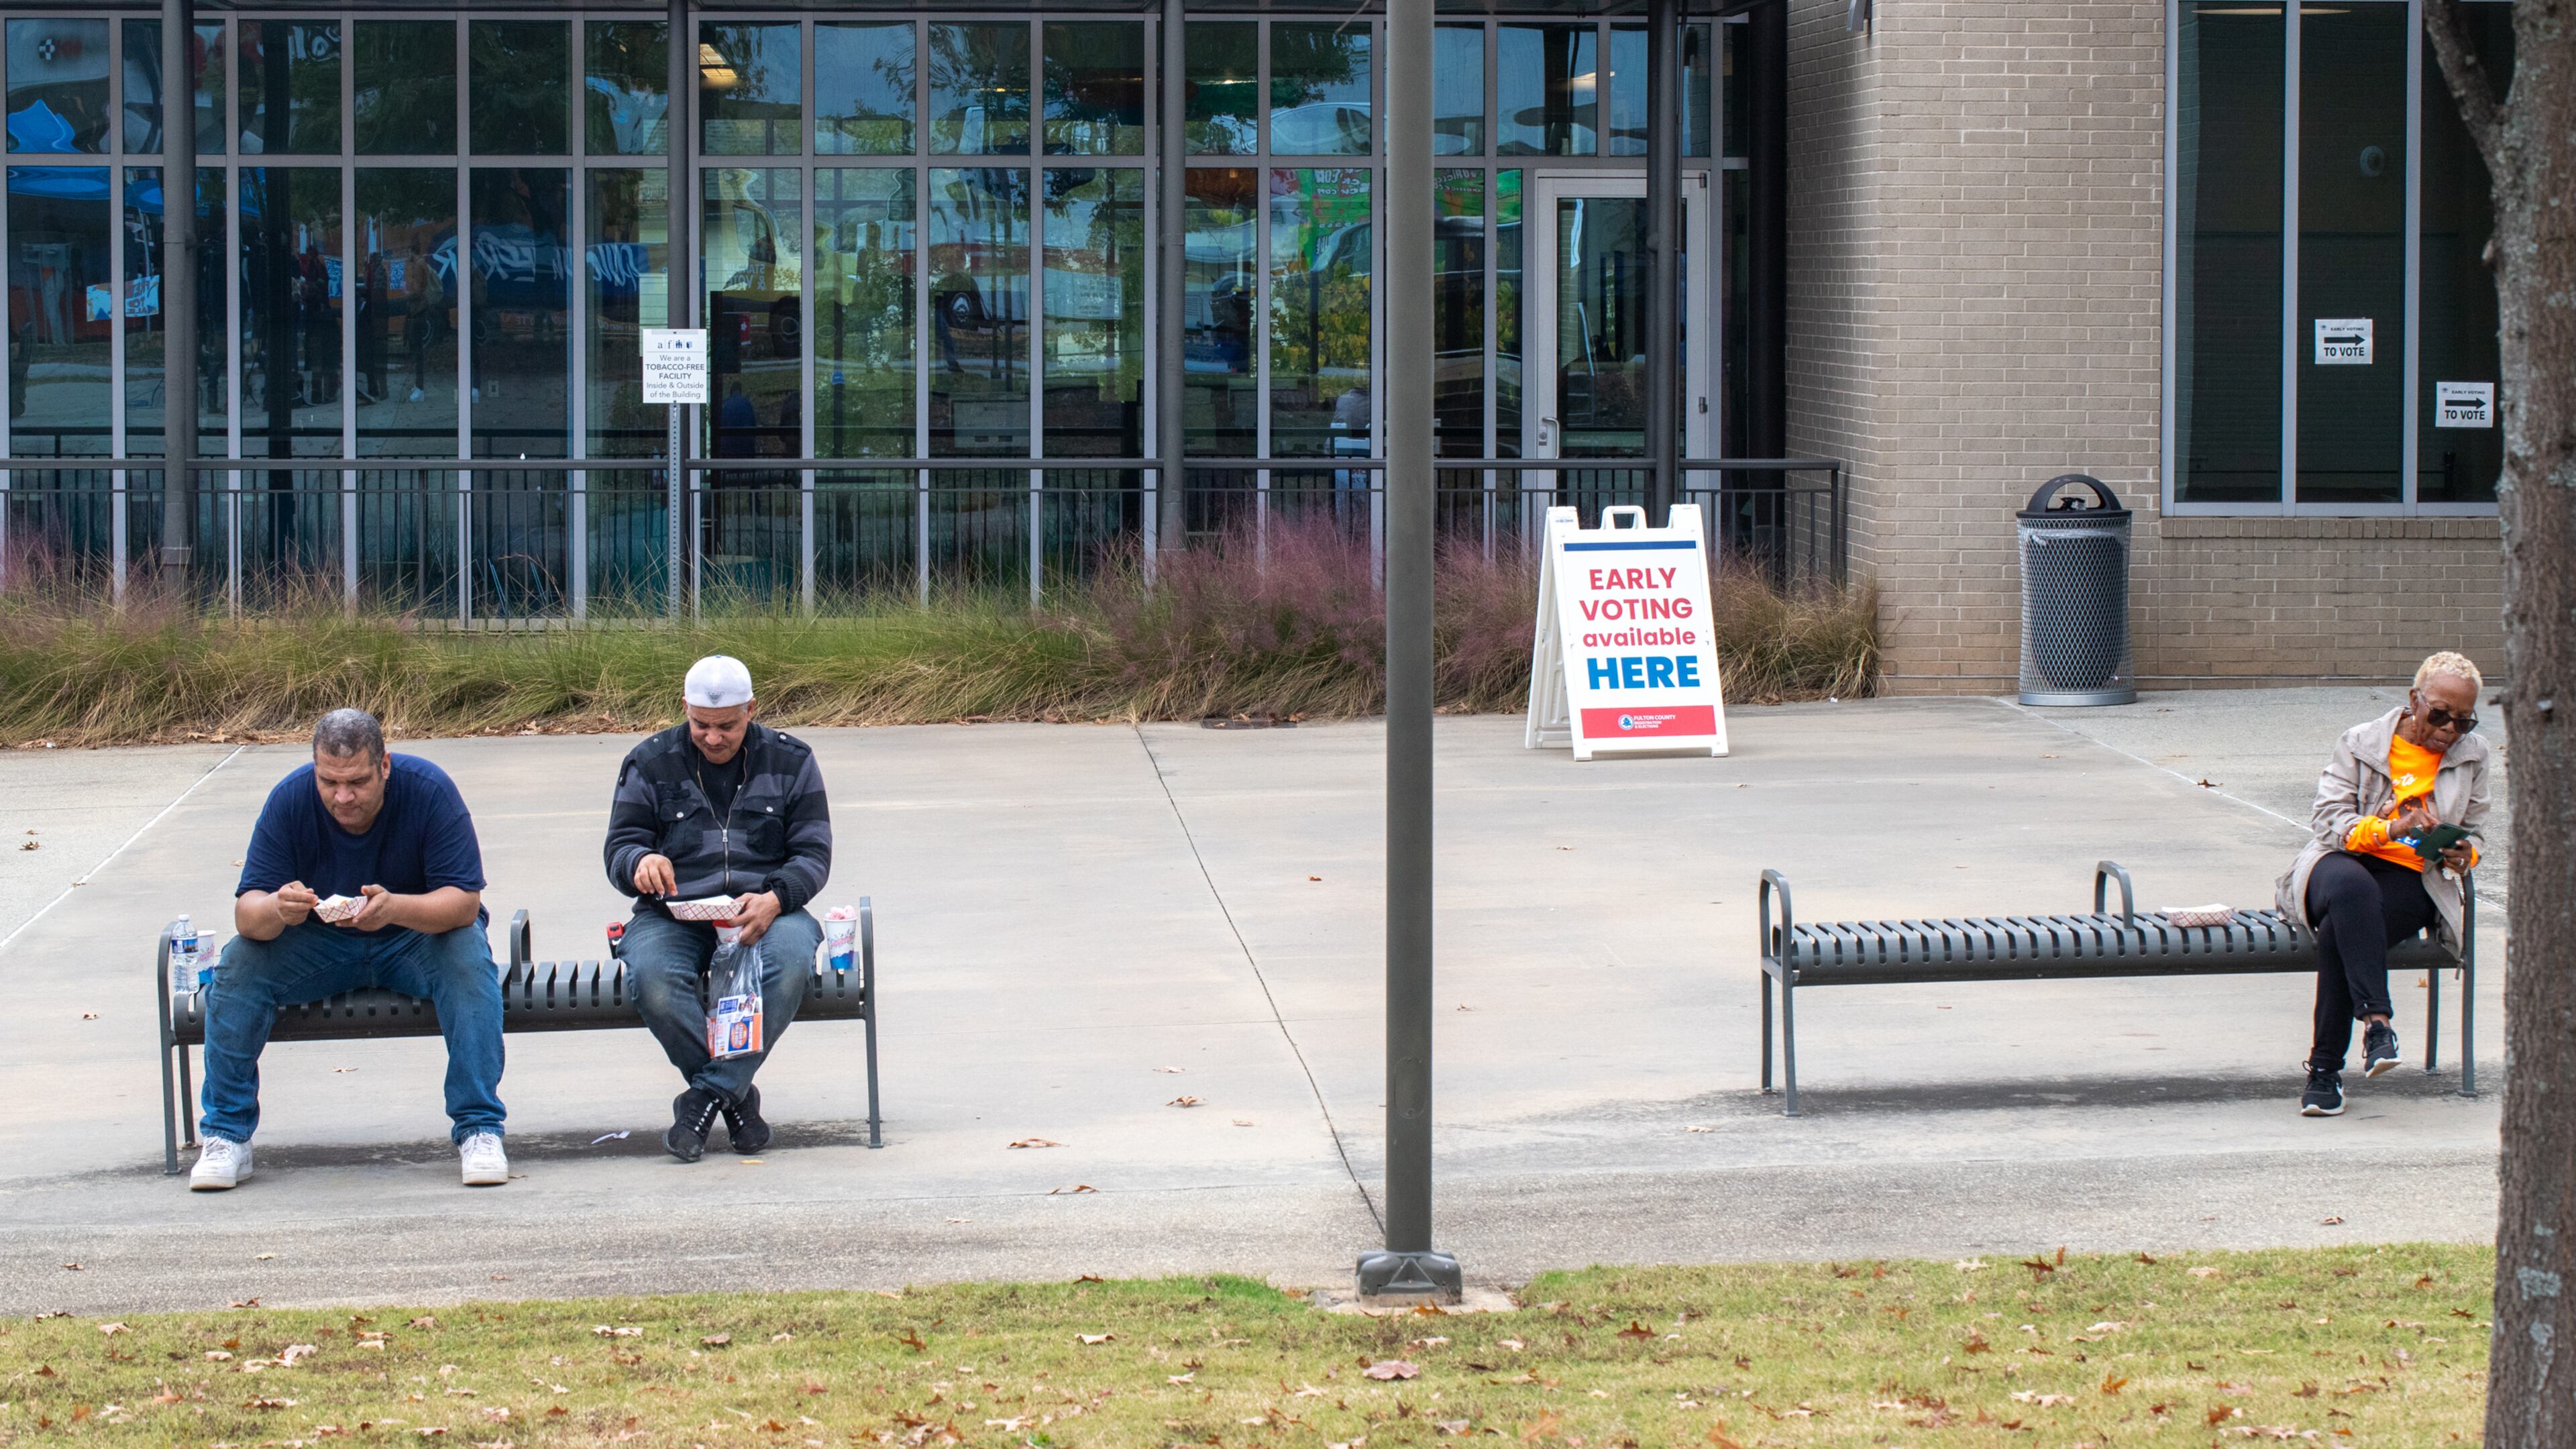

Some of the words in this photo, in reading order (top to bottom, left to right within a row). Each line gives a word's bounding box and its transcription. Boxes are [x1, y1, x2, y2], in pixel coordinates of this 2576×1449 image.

[2324, 347, 2337, 356] TO
[2339, 347, 2365, 356] VOTE
[672, 391, 700, 399] Building
[2445, 410, 2457, 419] TO
[2461, 410, 2485, 420] VOTE
[1589, 568, 1676, 590] EARLY
[1579, 598, 1693, 621] VOTING
[1582, 627, 1696, 647] available
[1587, 655, 1700, 690] HERE
[2400, 772, 2418, 787] to
